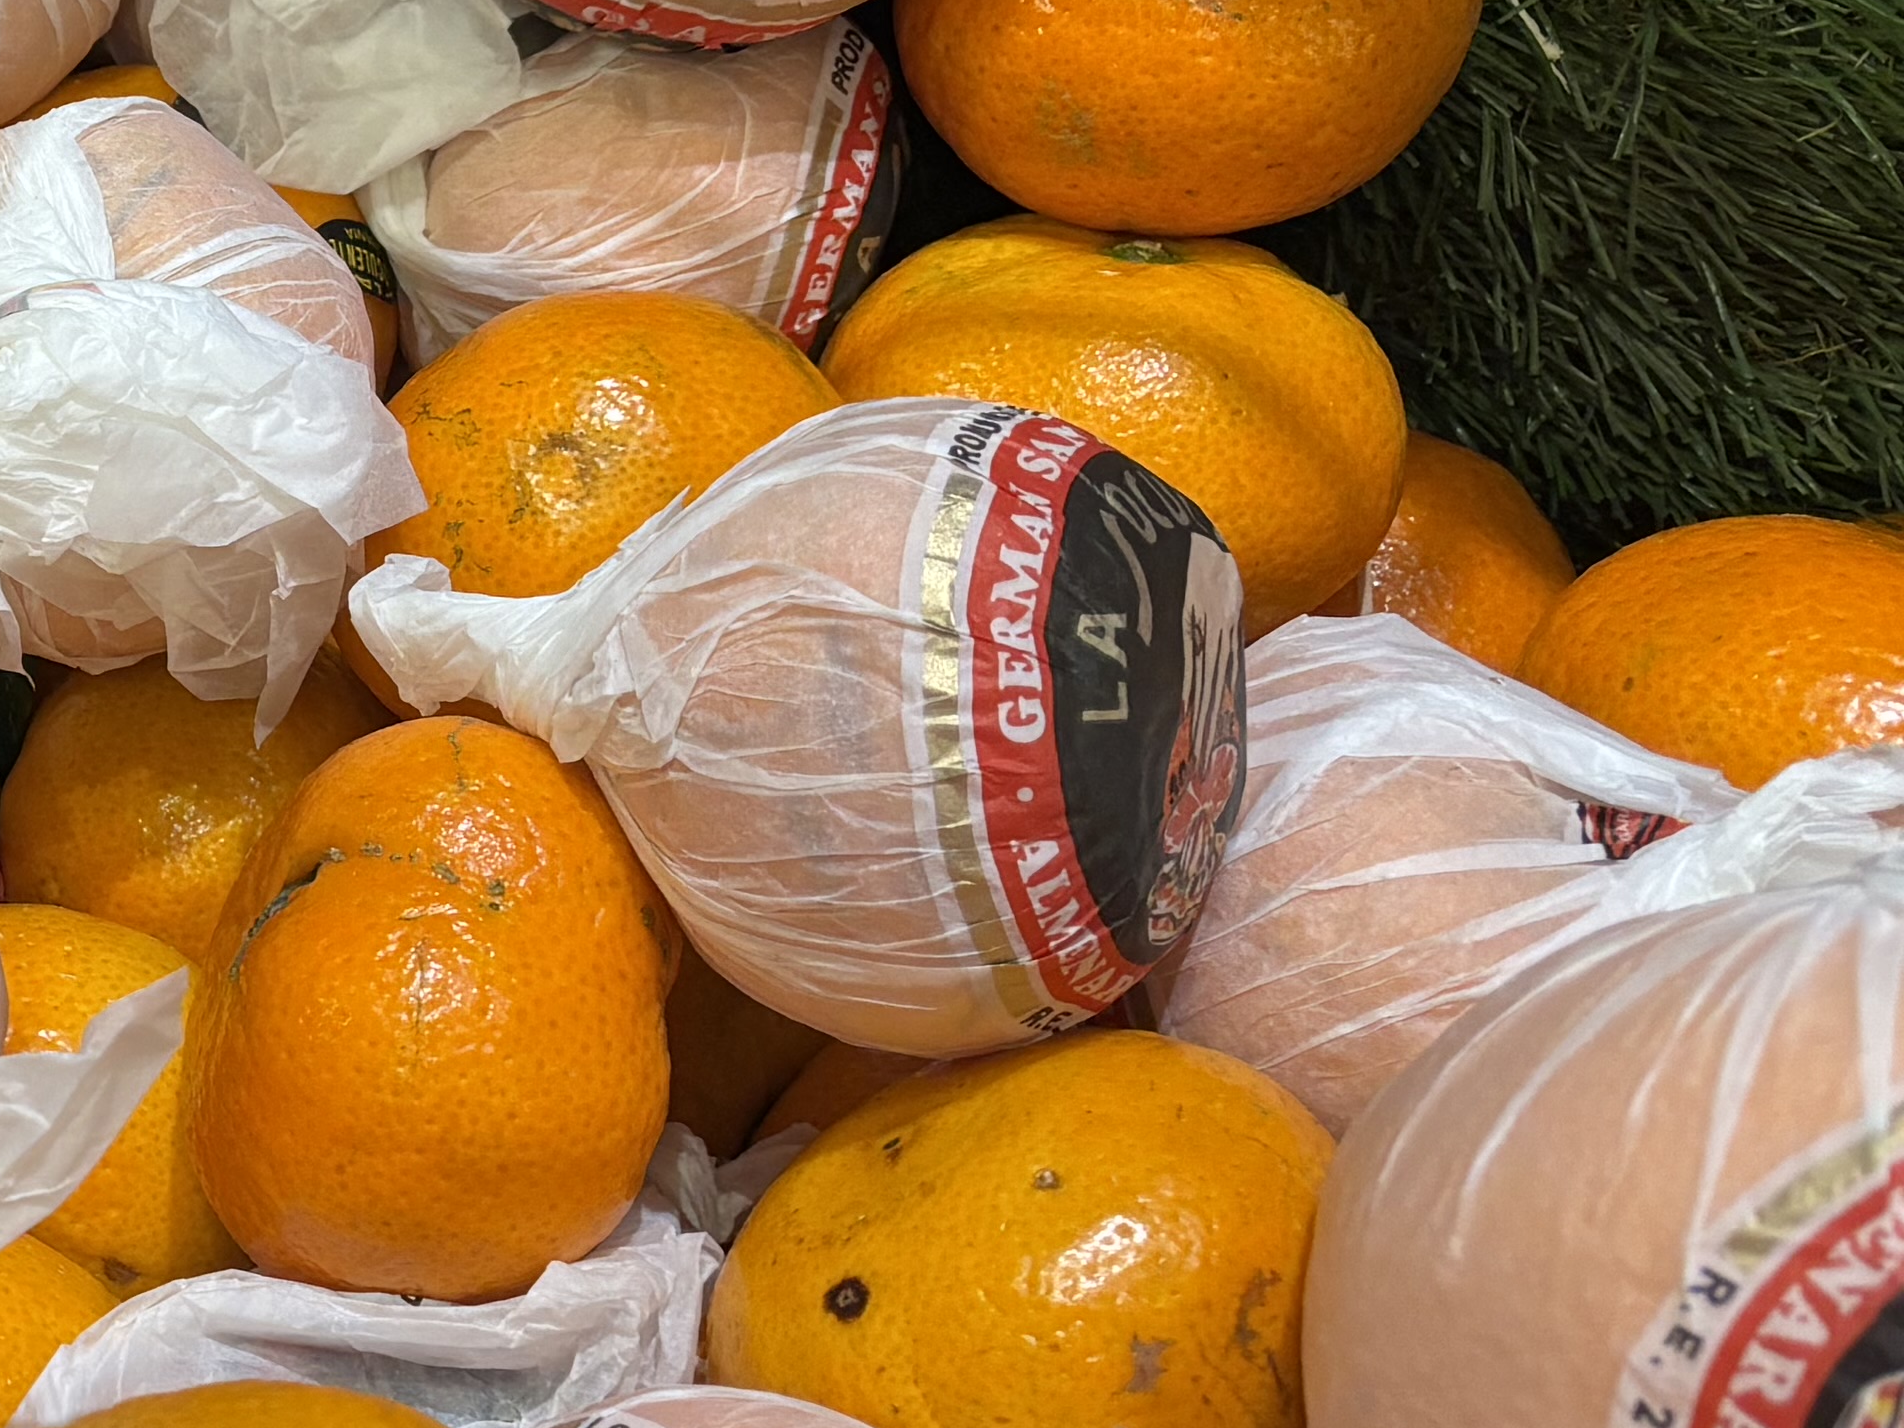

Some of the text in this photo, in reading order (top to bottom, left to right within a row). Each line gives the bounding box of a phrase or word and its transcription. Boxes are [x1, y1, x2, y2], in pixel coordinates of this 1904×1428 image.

[830, 28, 866, 95] PROD
[989, 424, 1090, 745] GERMAN SAN
[1076, 609, 1129, 724] LA
[1014, 834, 1136, 1006] ALMENAR
[1648, 1264, 1741, 1367] R.E.
